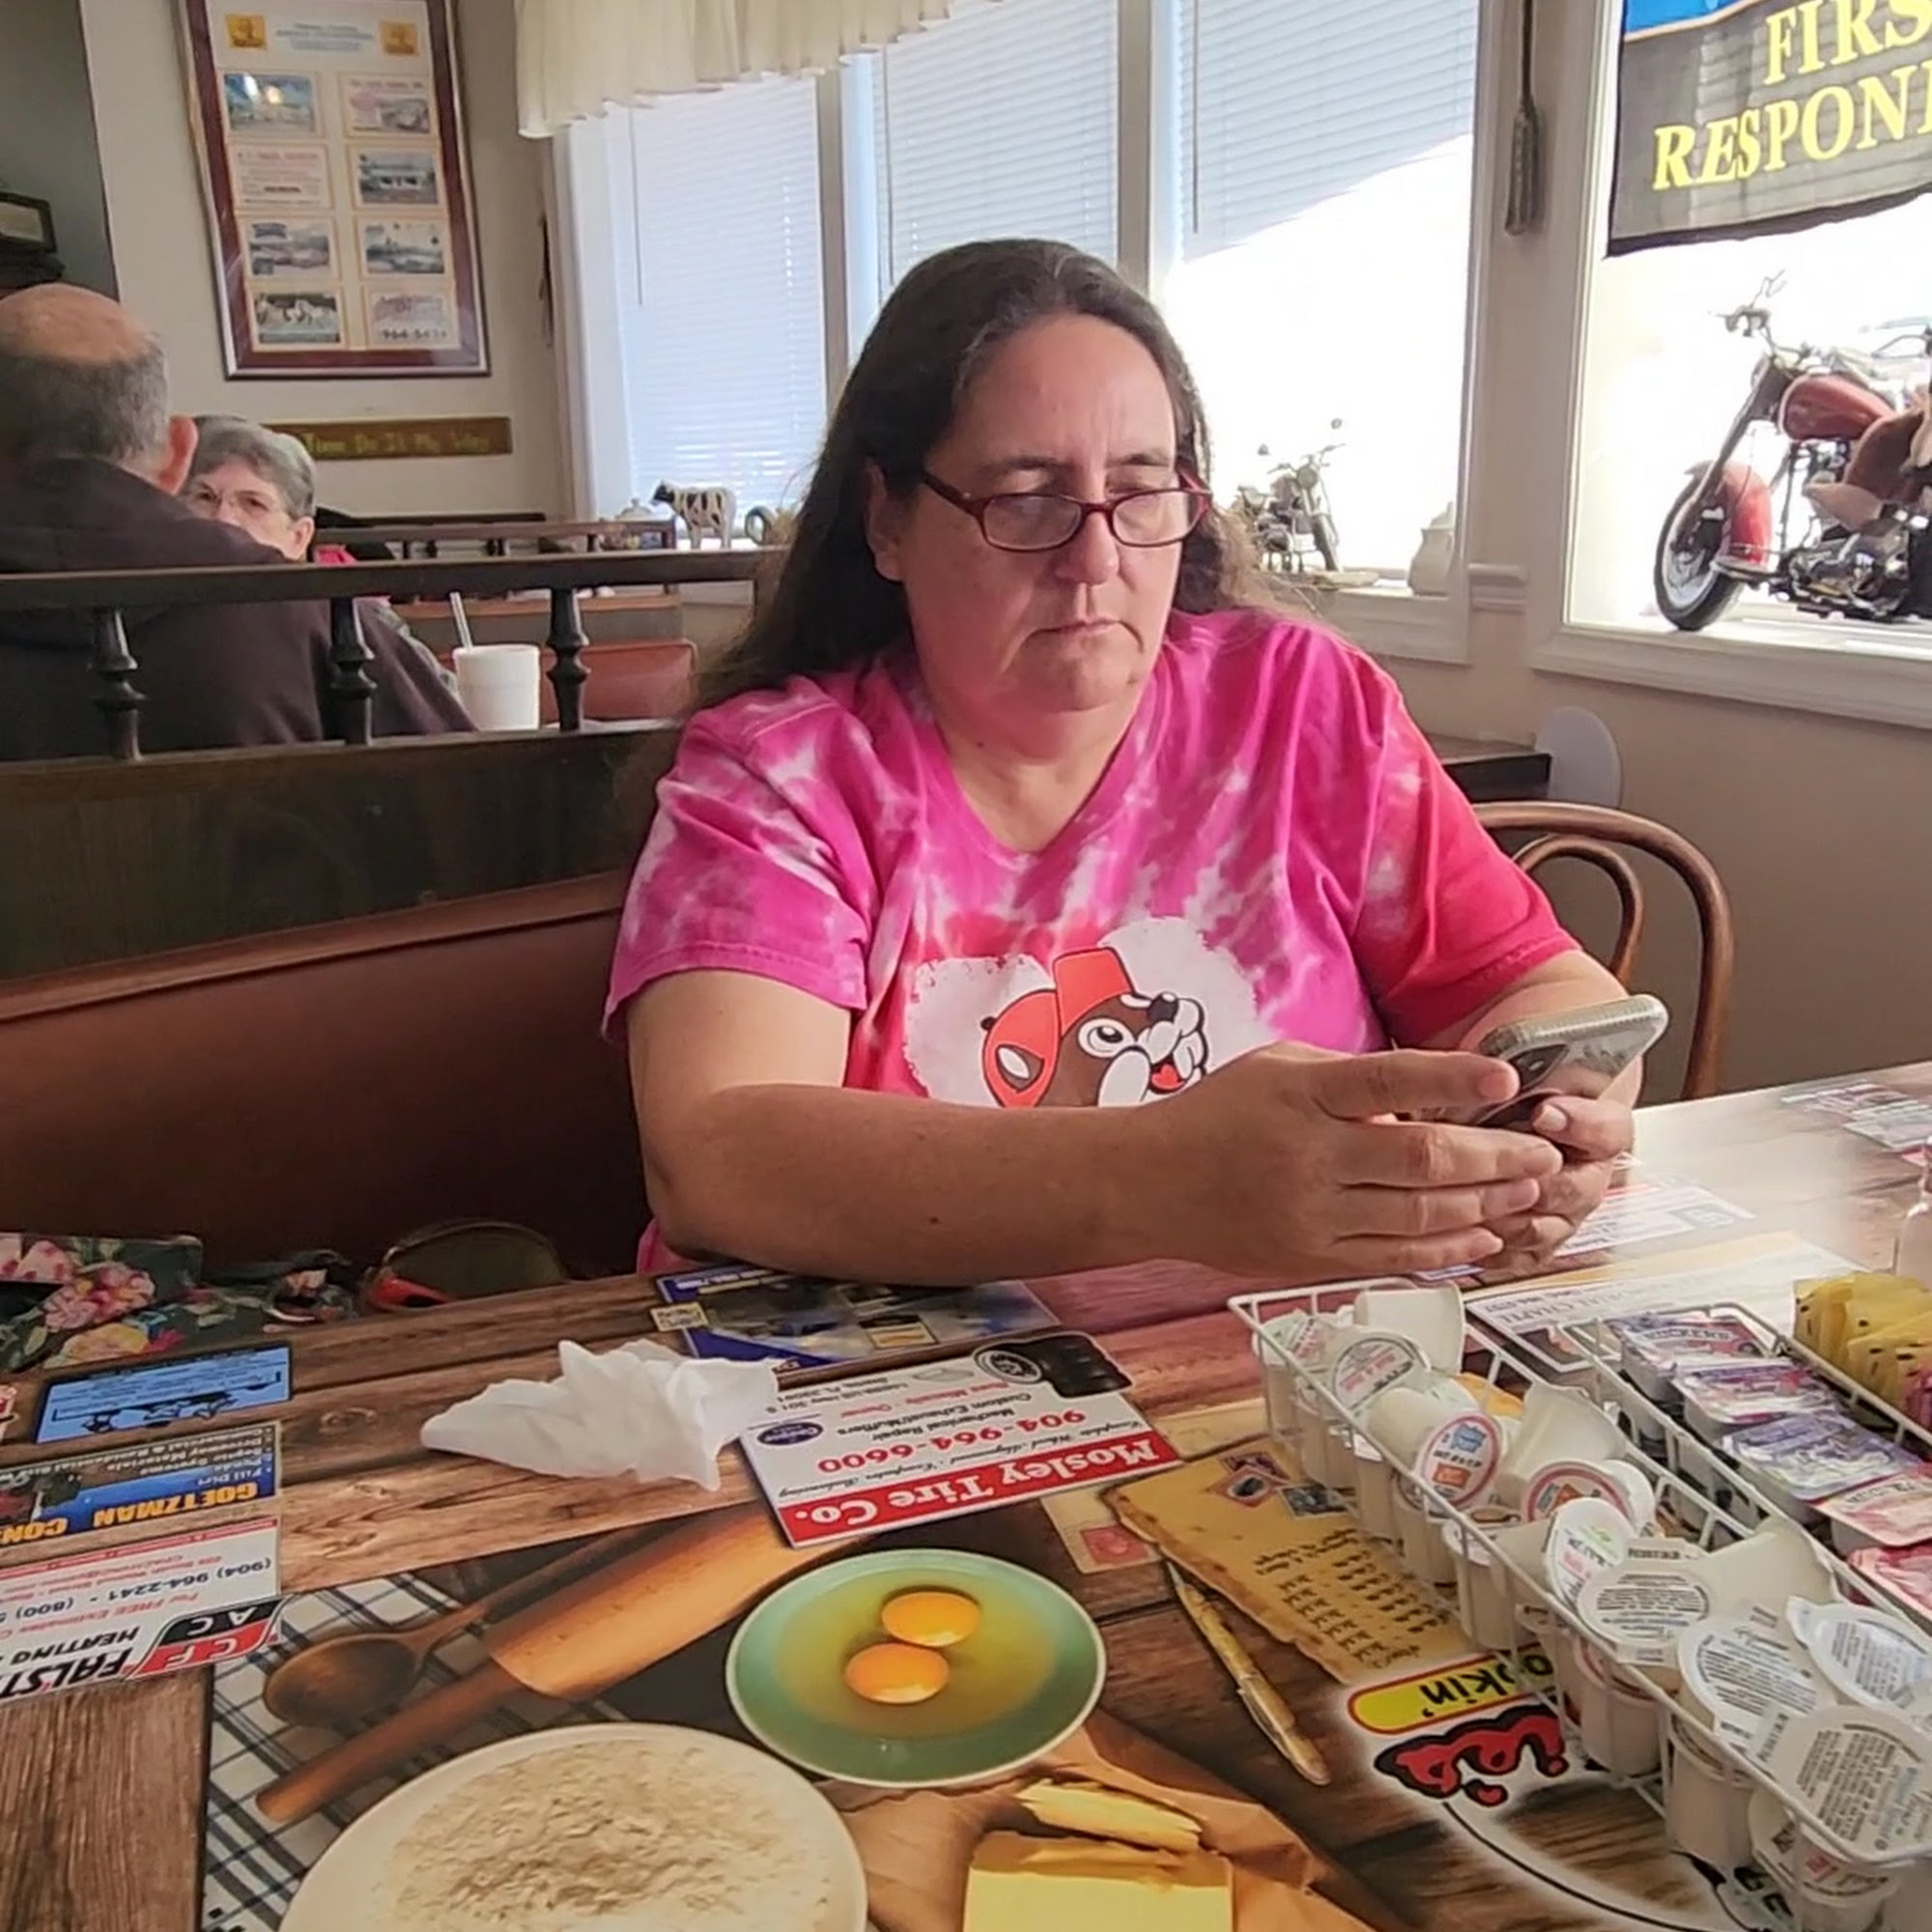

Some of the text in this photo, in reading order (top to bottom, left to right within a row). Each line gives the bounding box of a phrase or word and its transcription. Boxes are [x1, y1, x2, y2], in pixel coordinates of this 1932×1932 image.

[817, 1409, 1086, 1473] 904-964-6600
[871, 1408, 1014, 1441] Mechanical Repair
[794, 1438, 1158, 1525] Mosley Tire Co.
[93, 1481, 258, 1528] GOETZMAN
[215, 1556, 271, 1579] (904)
[107, 1572, 209, 1602] 964-2241
[14, 1596, 75, 1621] (800)
